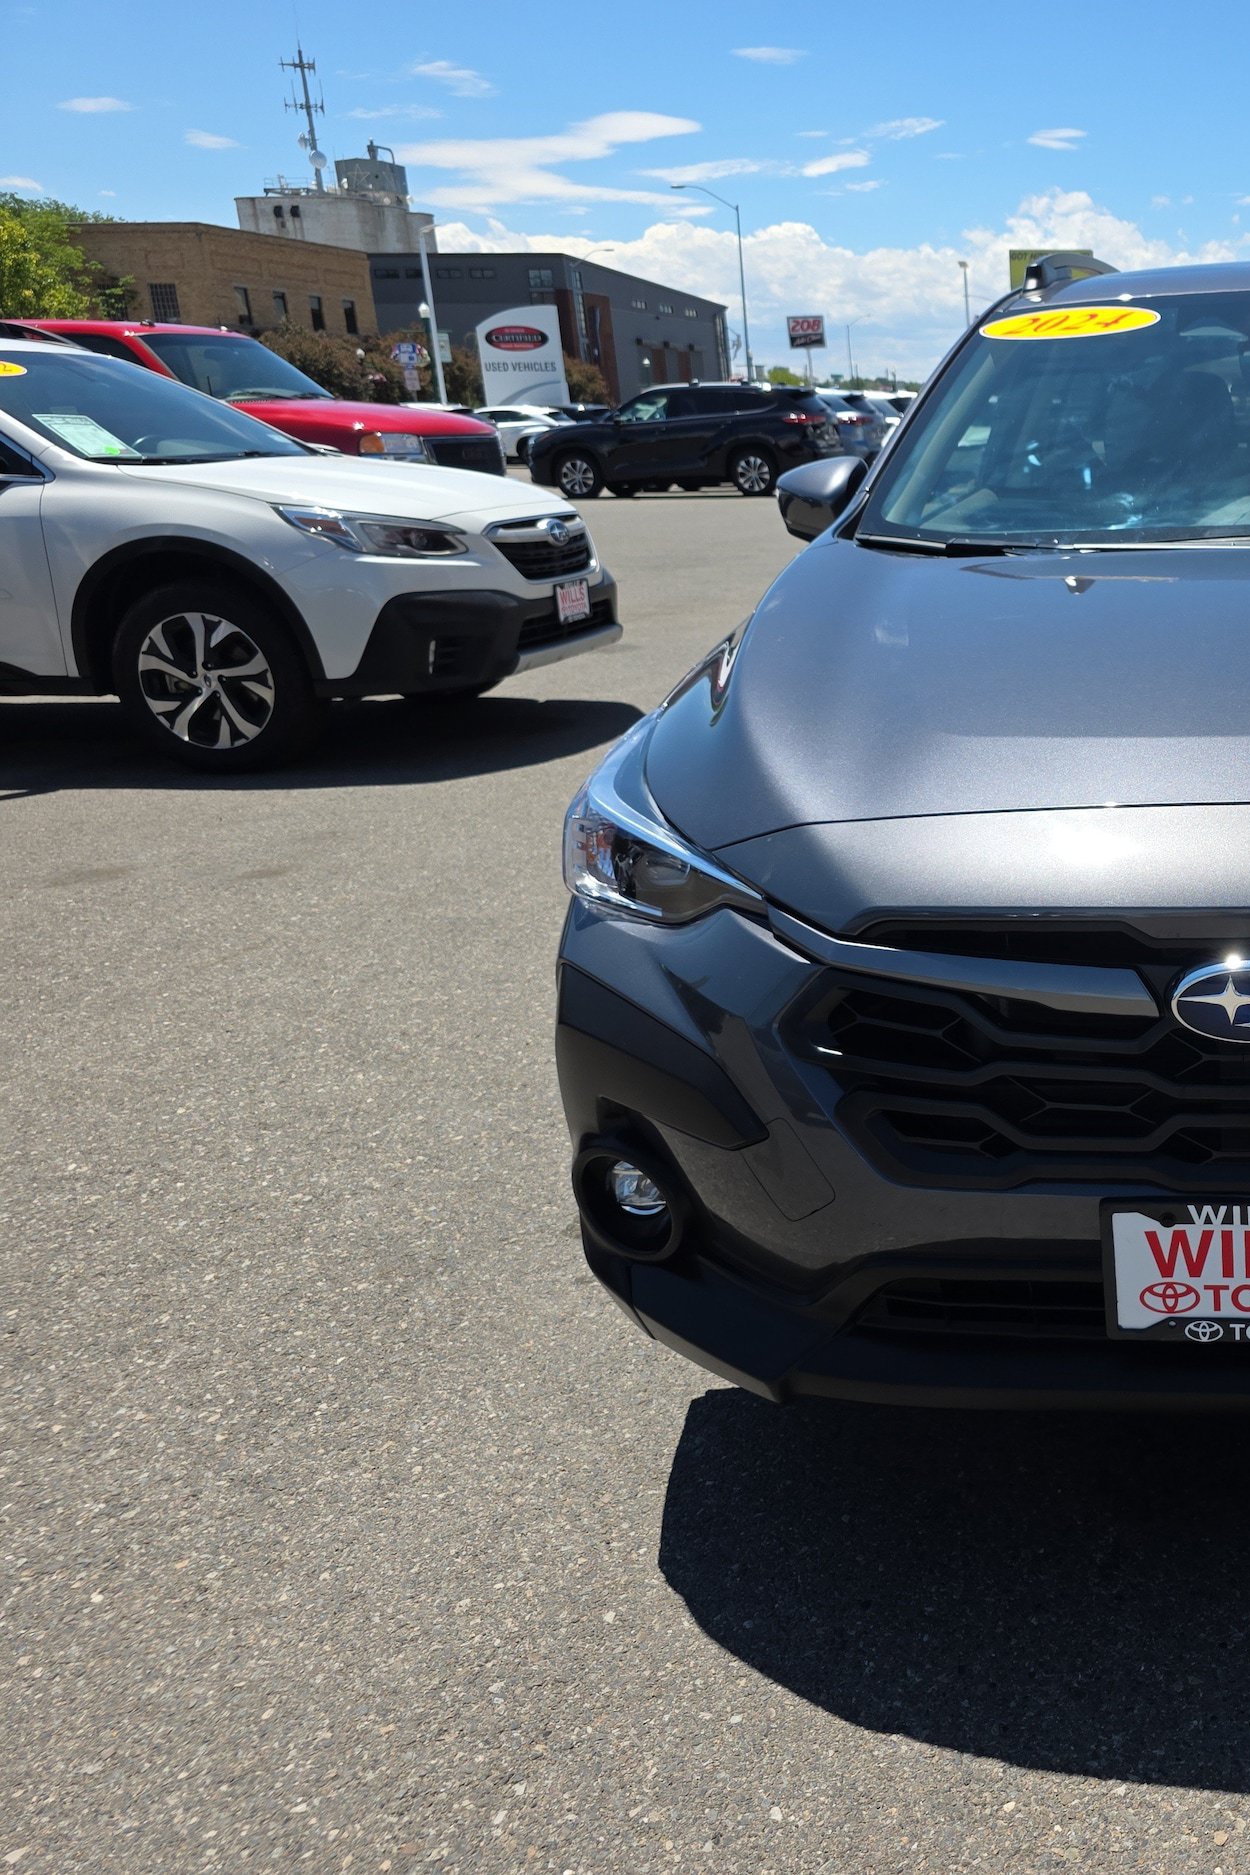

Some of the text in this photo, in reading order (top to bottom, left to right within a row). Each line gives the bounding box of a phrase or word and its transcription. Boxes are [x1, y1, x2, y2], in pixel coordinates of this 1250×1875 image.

[1011, 252, 1027, 261] GOT
[791, 319, 820, 332] 208
[1000, 311, 1135, 335] 2024
[485, 361, 557, 372] USED VEHICLES
[560, 586, 585, 605] WILLS
